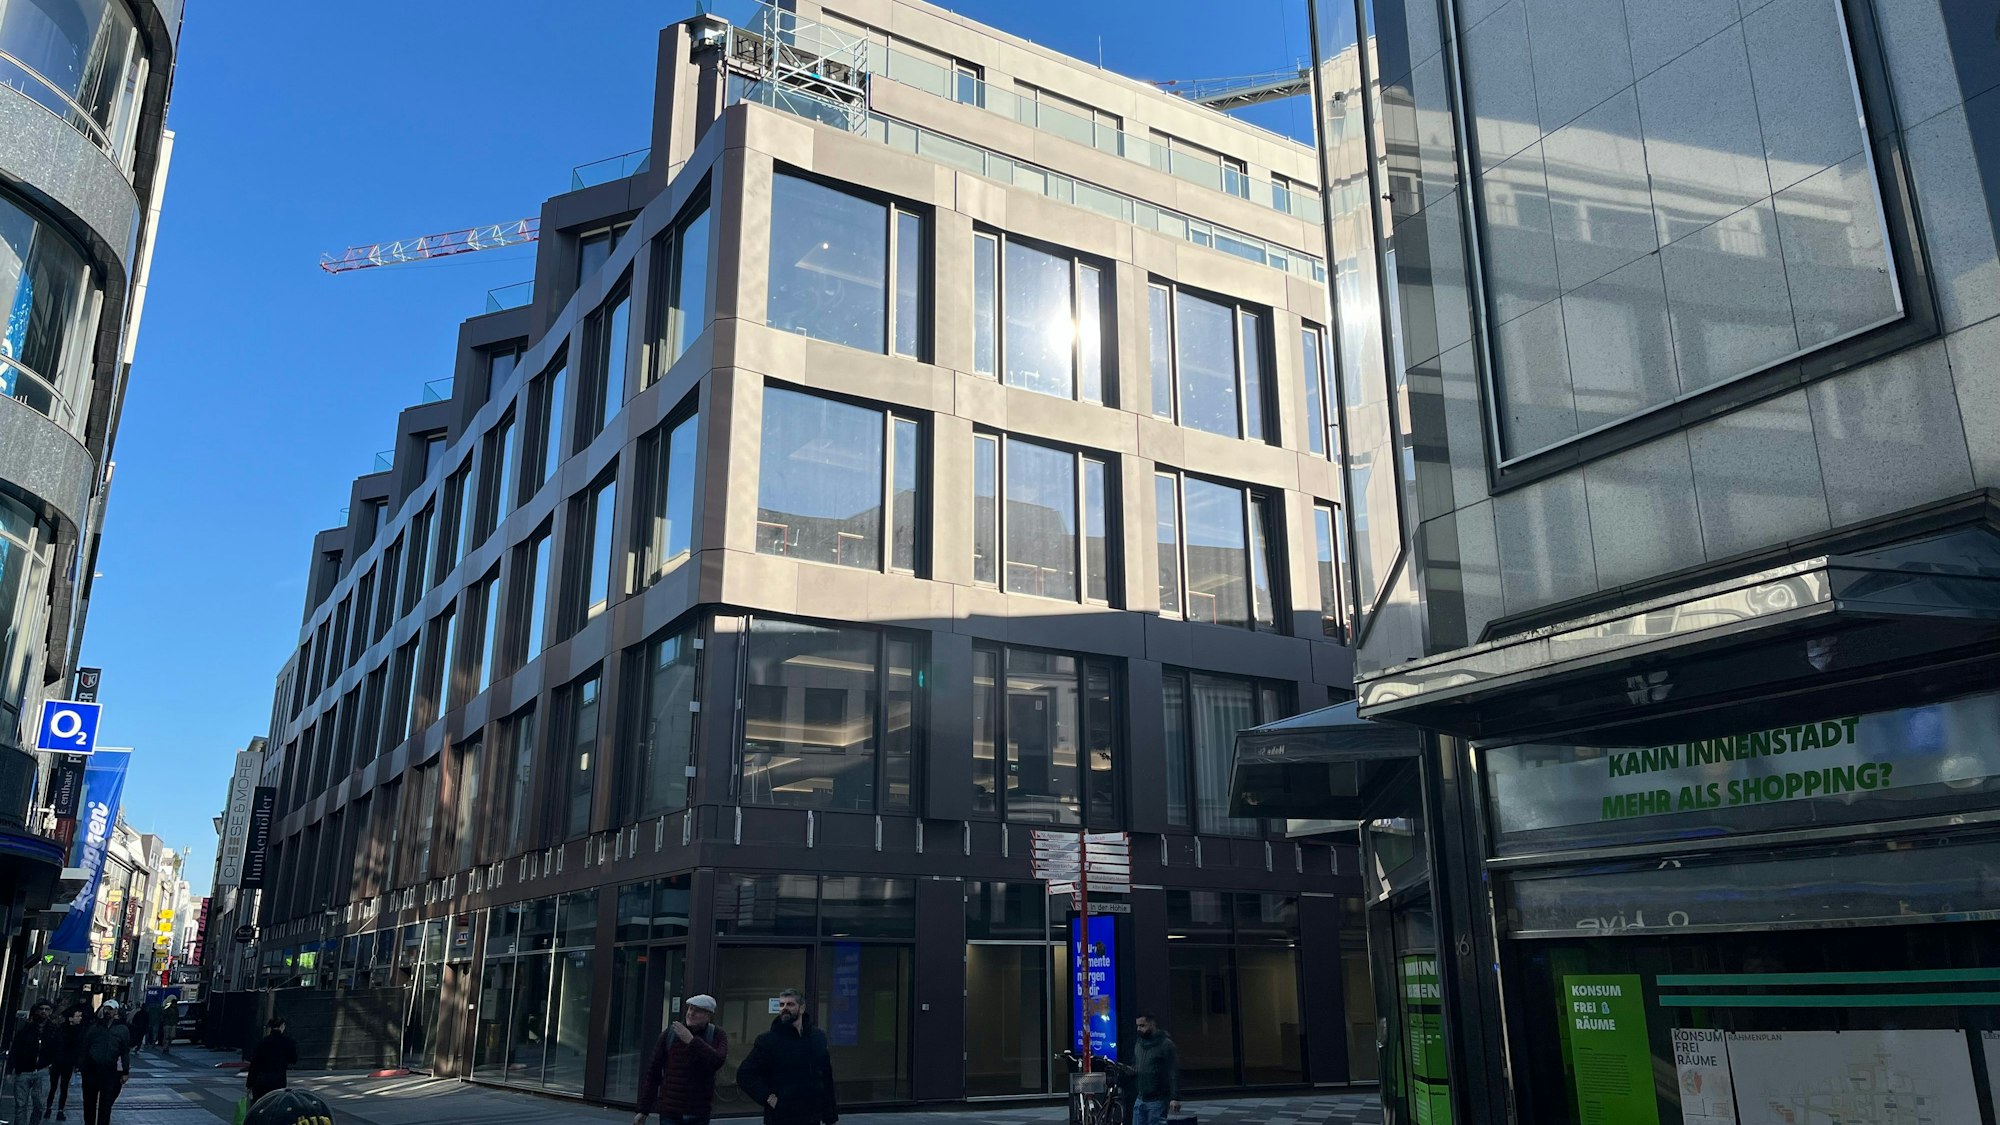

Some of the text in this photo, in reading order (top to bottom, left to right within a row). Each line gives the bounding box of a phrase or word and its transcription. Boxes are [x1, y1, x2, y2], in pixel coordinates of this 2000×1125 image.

[1608, 717, 1860, 778] KANN INNENSTADT
[1602, 762, 1893, 819] MEHR ALS SHOPPING?
[223, 815, 243, 879] CHEESE
[236, 757, 253, 802] MORE
[246, 795, 273, 881] hunkemöller
[1571, 985, 1622, 997] KONSUM
[1573, 1001, 1597, 1013] FREI
[1575, 1015, 1616, 1031] RÄUME
[1674, 1031, 1723, 1042] KONSUM
[1728, 1033, 1782, 1041] RAHMENPLAN
[1675, 1042, 1700, 1053] FREI
[1677, 1054, 1718, 1067] RÄUME
